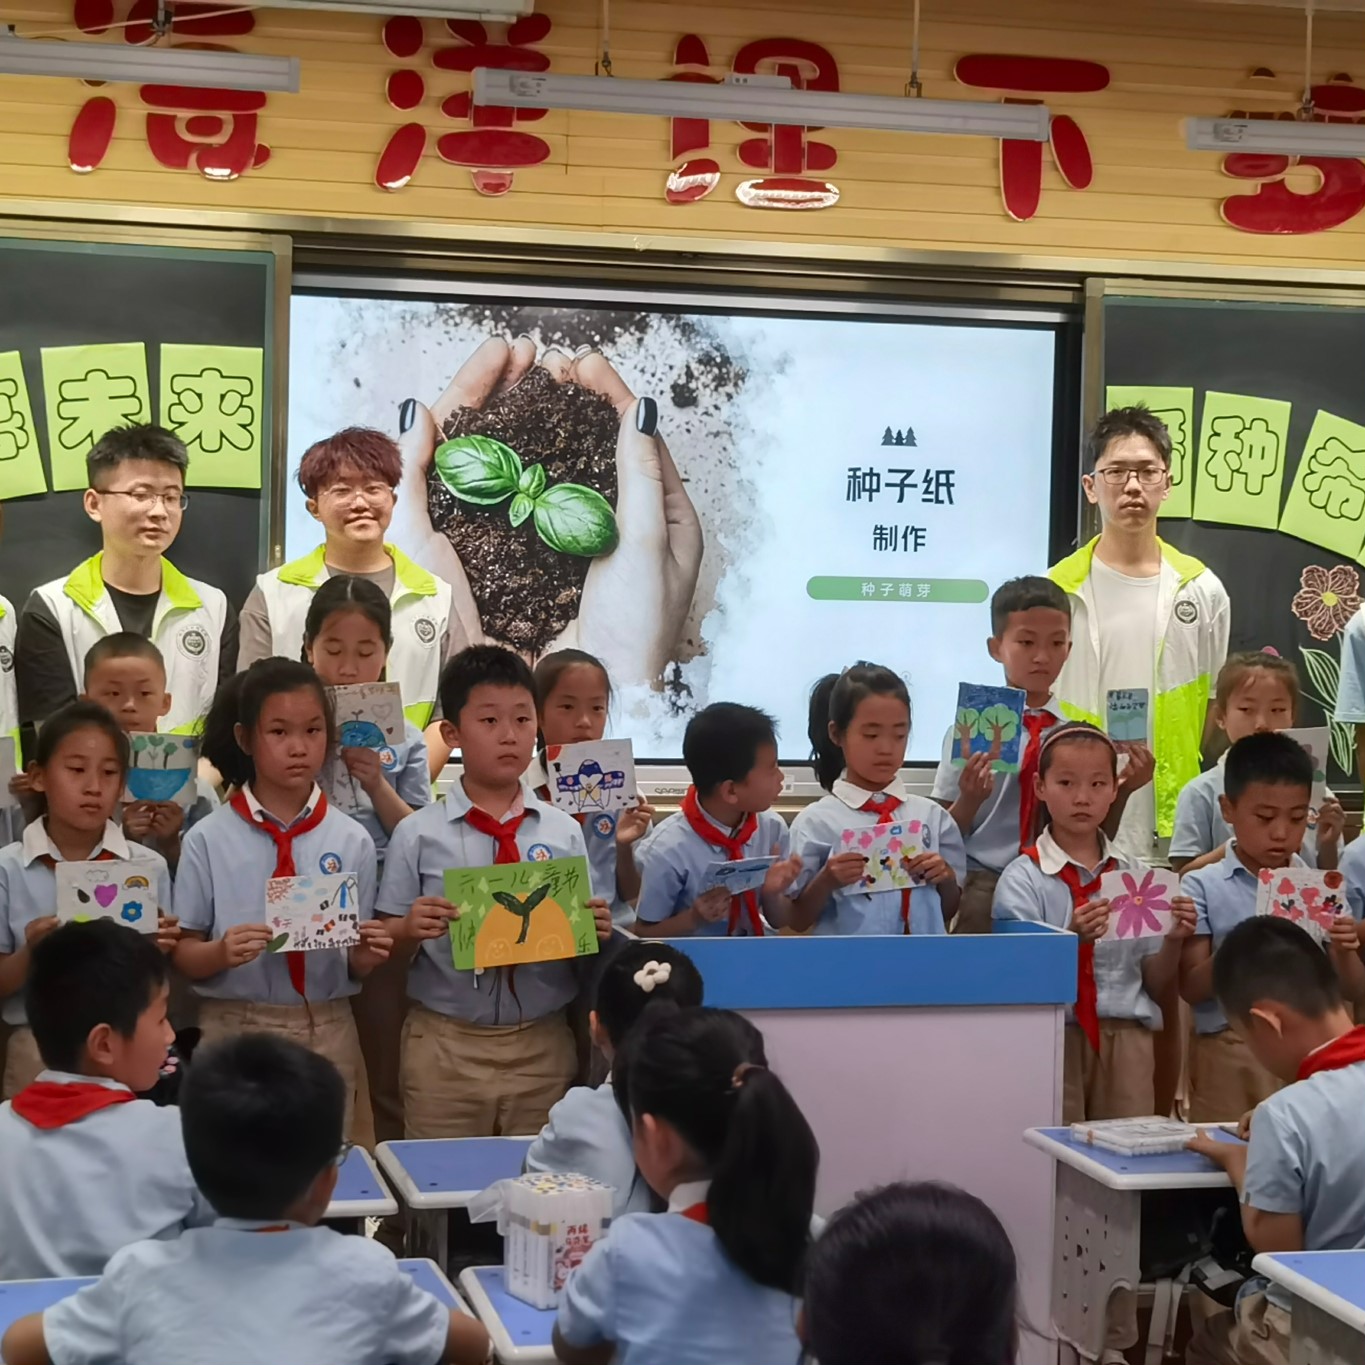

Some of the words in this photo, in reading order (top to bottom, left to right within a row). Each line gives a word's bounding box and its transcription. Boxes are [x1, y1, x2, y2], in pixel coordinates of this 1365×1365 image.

[846, 467, 955, 505] 种子纸
[873, 524, 927, 552] 制作
[860, 581, 931, 598] 种子萌芽
